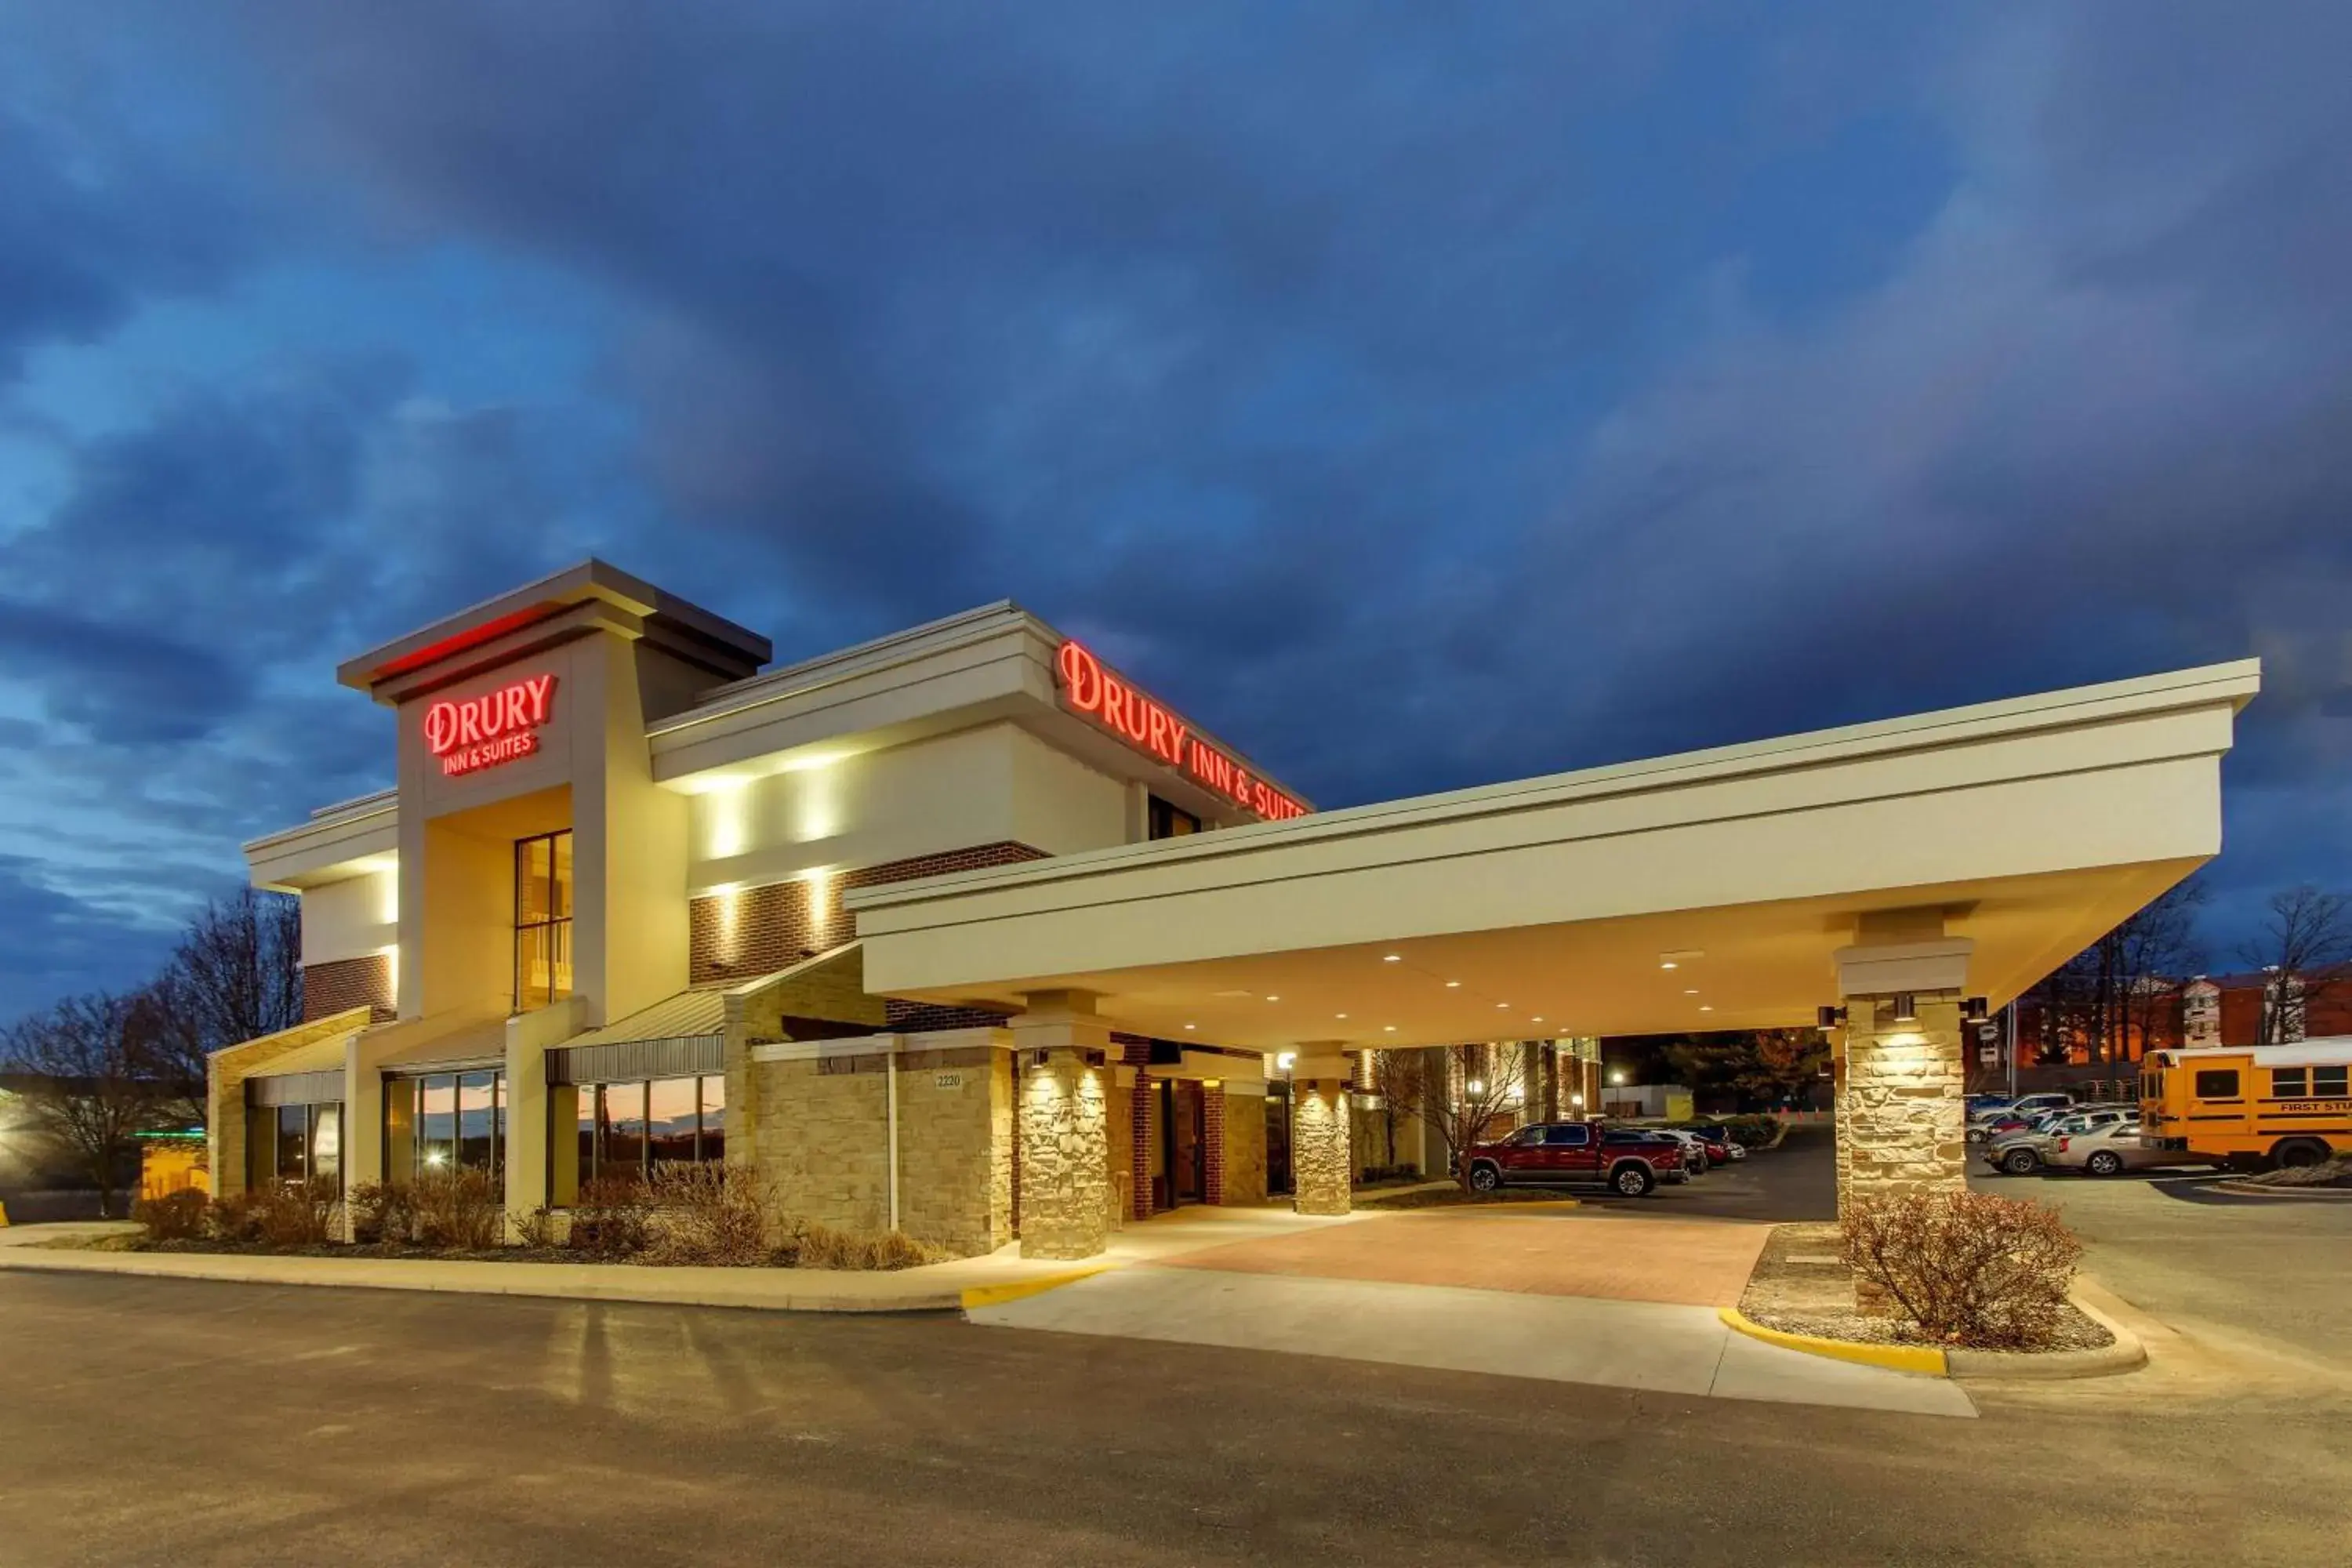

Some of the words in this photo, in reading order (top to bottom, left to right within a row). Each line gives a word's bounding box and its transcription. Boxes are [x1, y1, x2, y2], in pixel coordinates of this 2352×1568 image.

[424, 674, 550, 753] DRURY
[1061, 641, 1185, 764] DRURY
[1192, 739, 1230, 793] INN
[1236, 769, 1249, 804] &
[445, 752, 468, 775] INN
[470, 749, 480, 767] &
[482, 732, 531, 763] SUITES
[938, 1075, 960, 1087] 2220
[2281, 1102, 2321, 1111] FIRST
